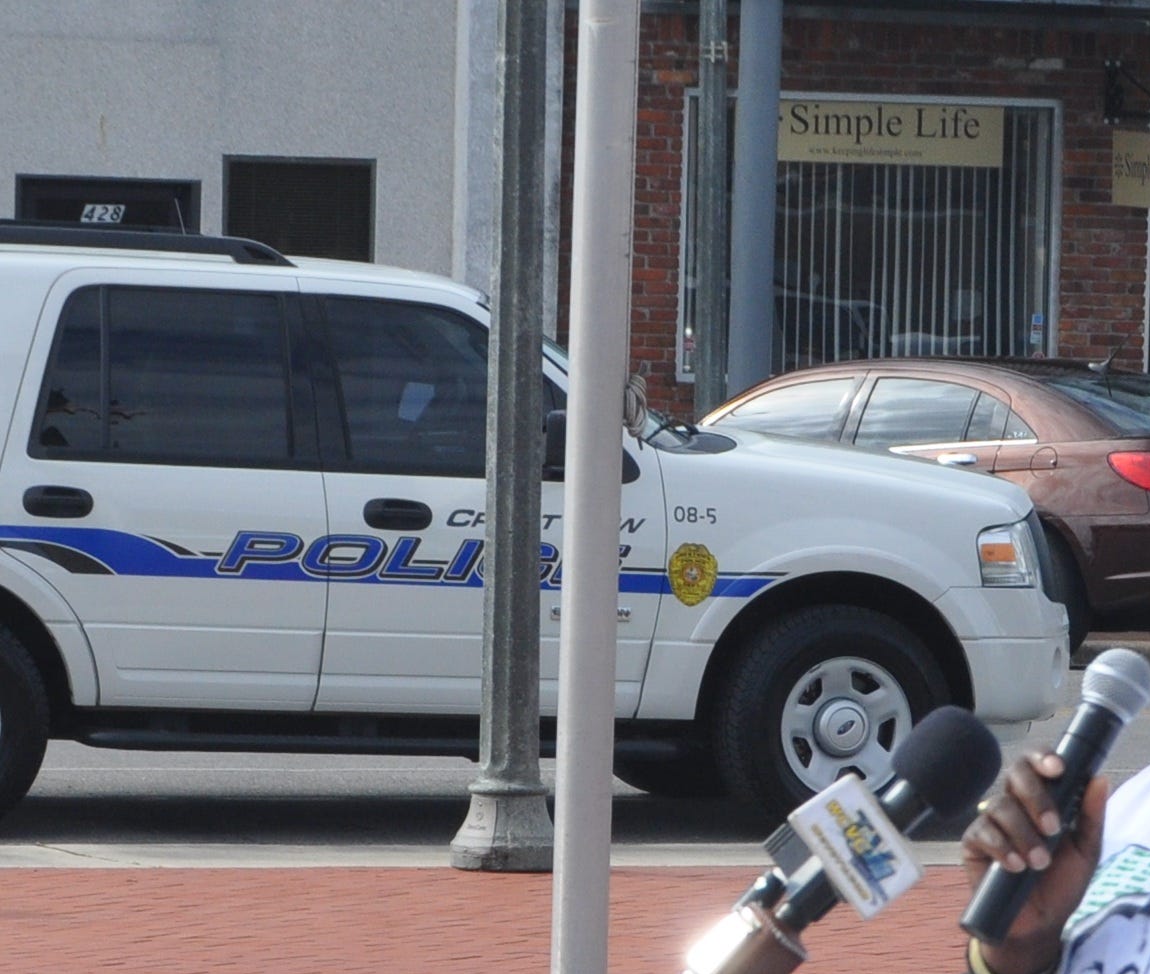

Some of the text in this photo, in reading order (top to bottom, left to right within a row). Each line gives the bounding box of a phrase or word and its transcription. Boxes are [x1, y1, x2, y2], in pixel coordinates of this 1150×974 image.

[790, 104, 980, 144] Simple Life
[85, 206, 121, 220] 428
[673, 505, 717, 525] 08-5
